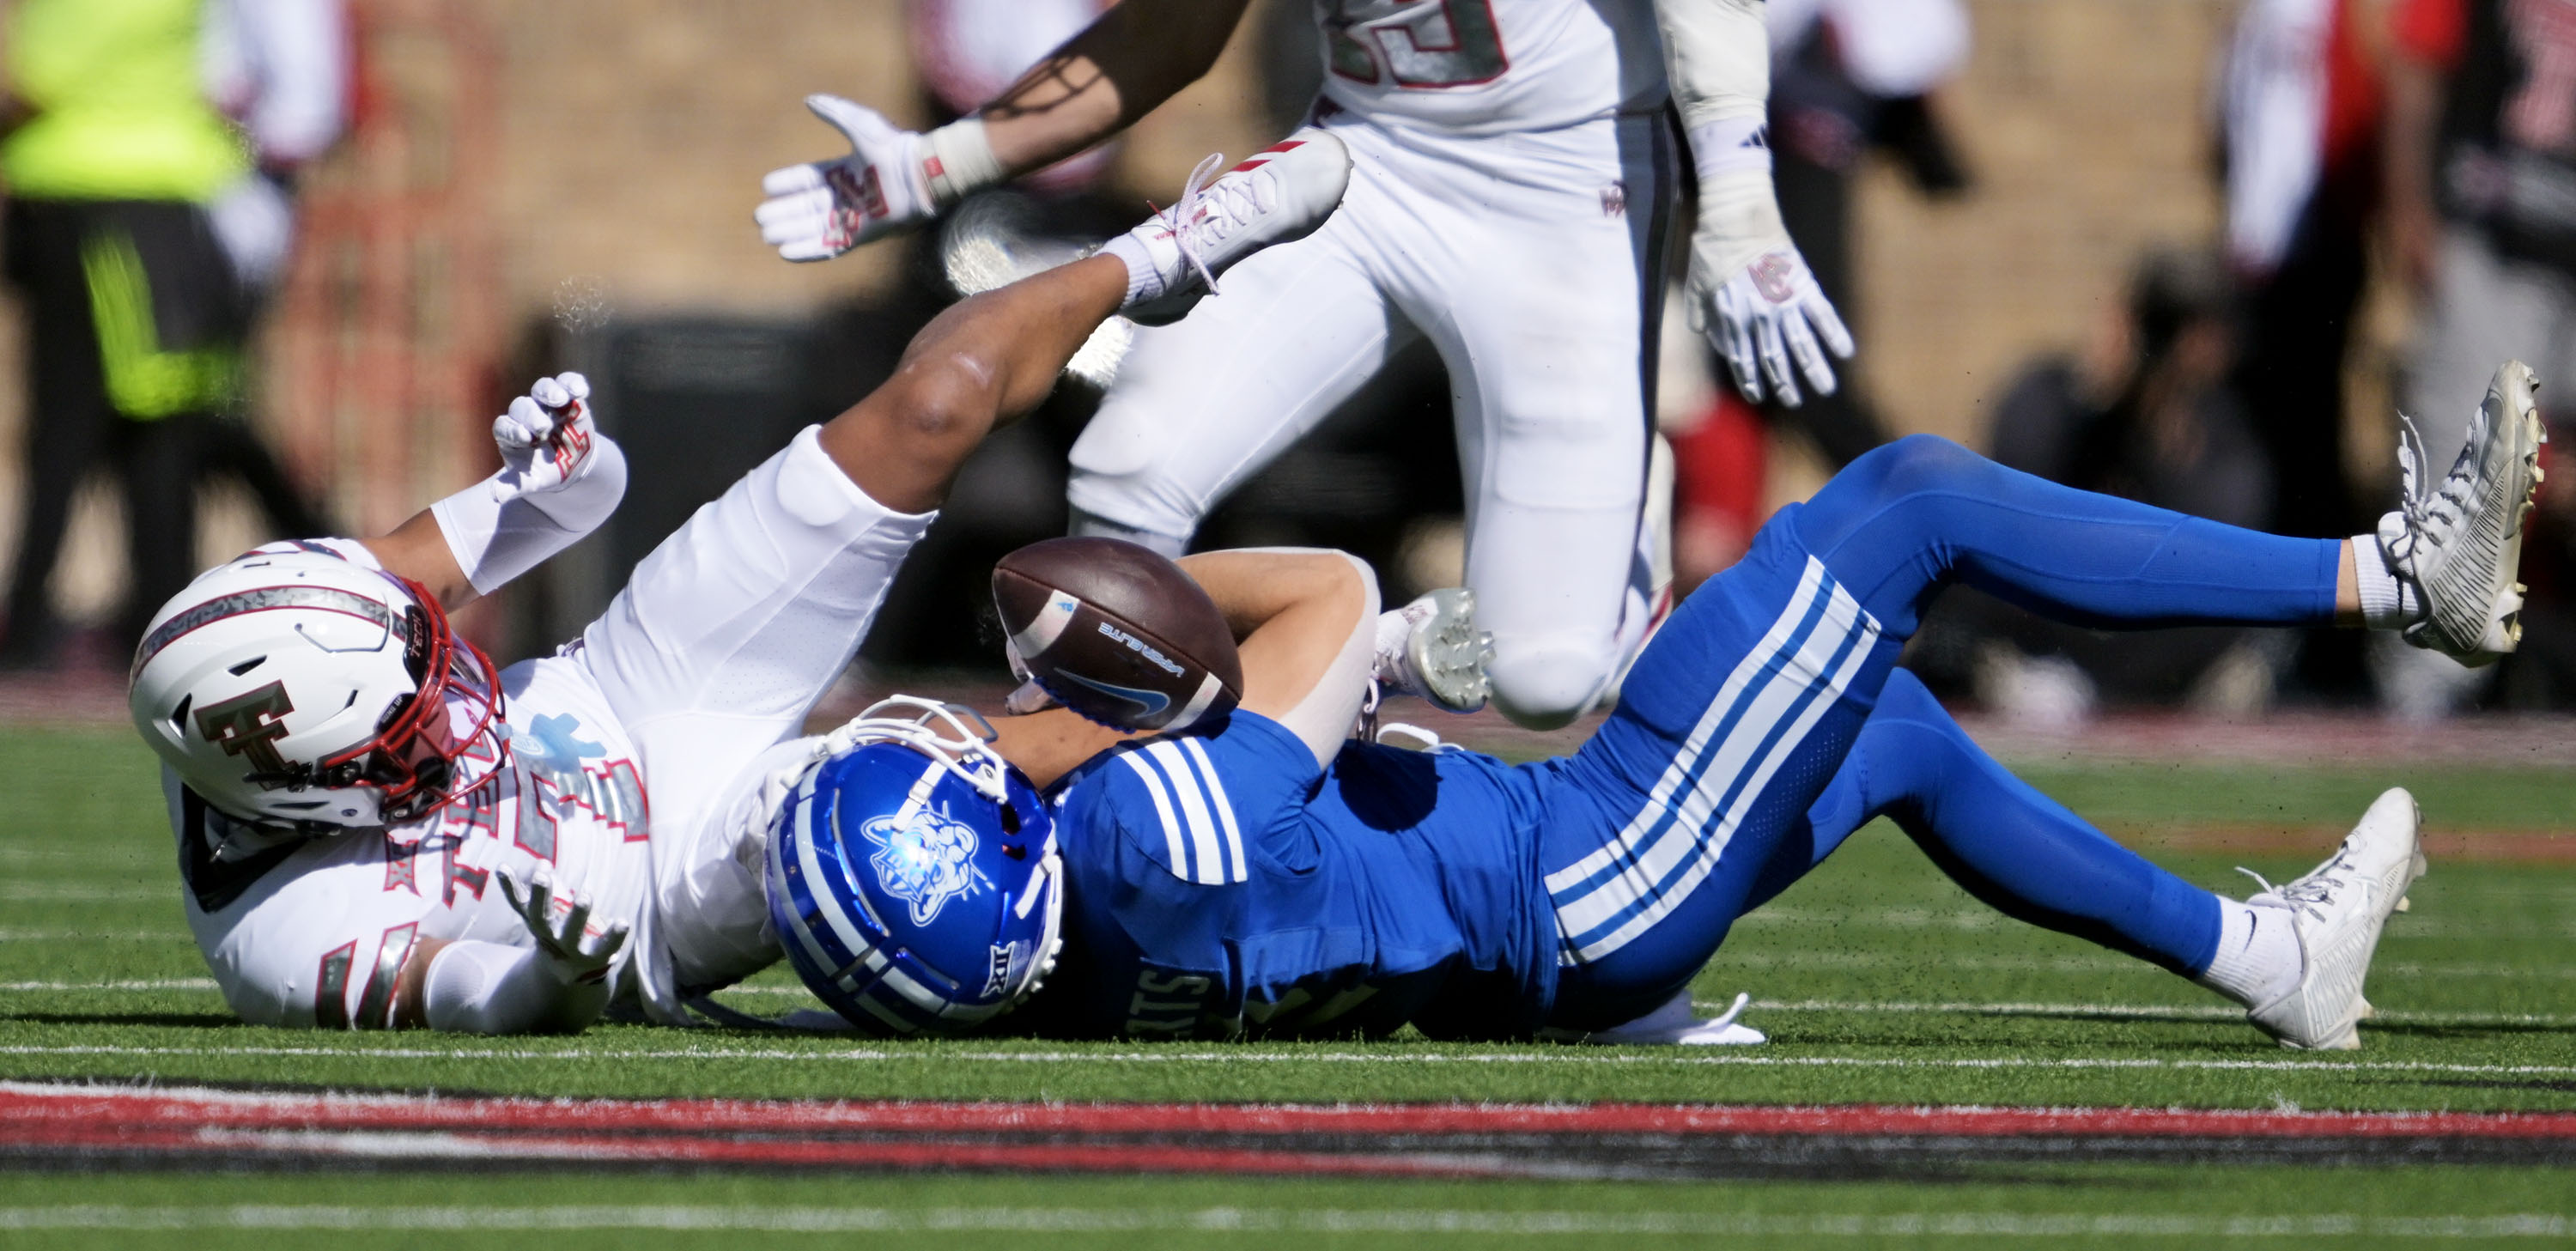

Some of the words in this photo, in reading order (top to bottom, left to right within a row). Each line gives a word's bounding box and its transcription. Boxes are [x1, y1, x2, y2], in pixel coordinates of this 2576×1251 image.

[410, 613, 423, 658] TECH
[1097, 622, 1144, 651] ELITE
[1141, 644, 1185, 677] VAPOR
